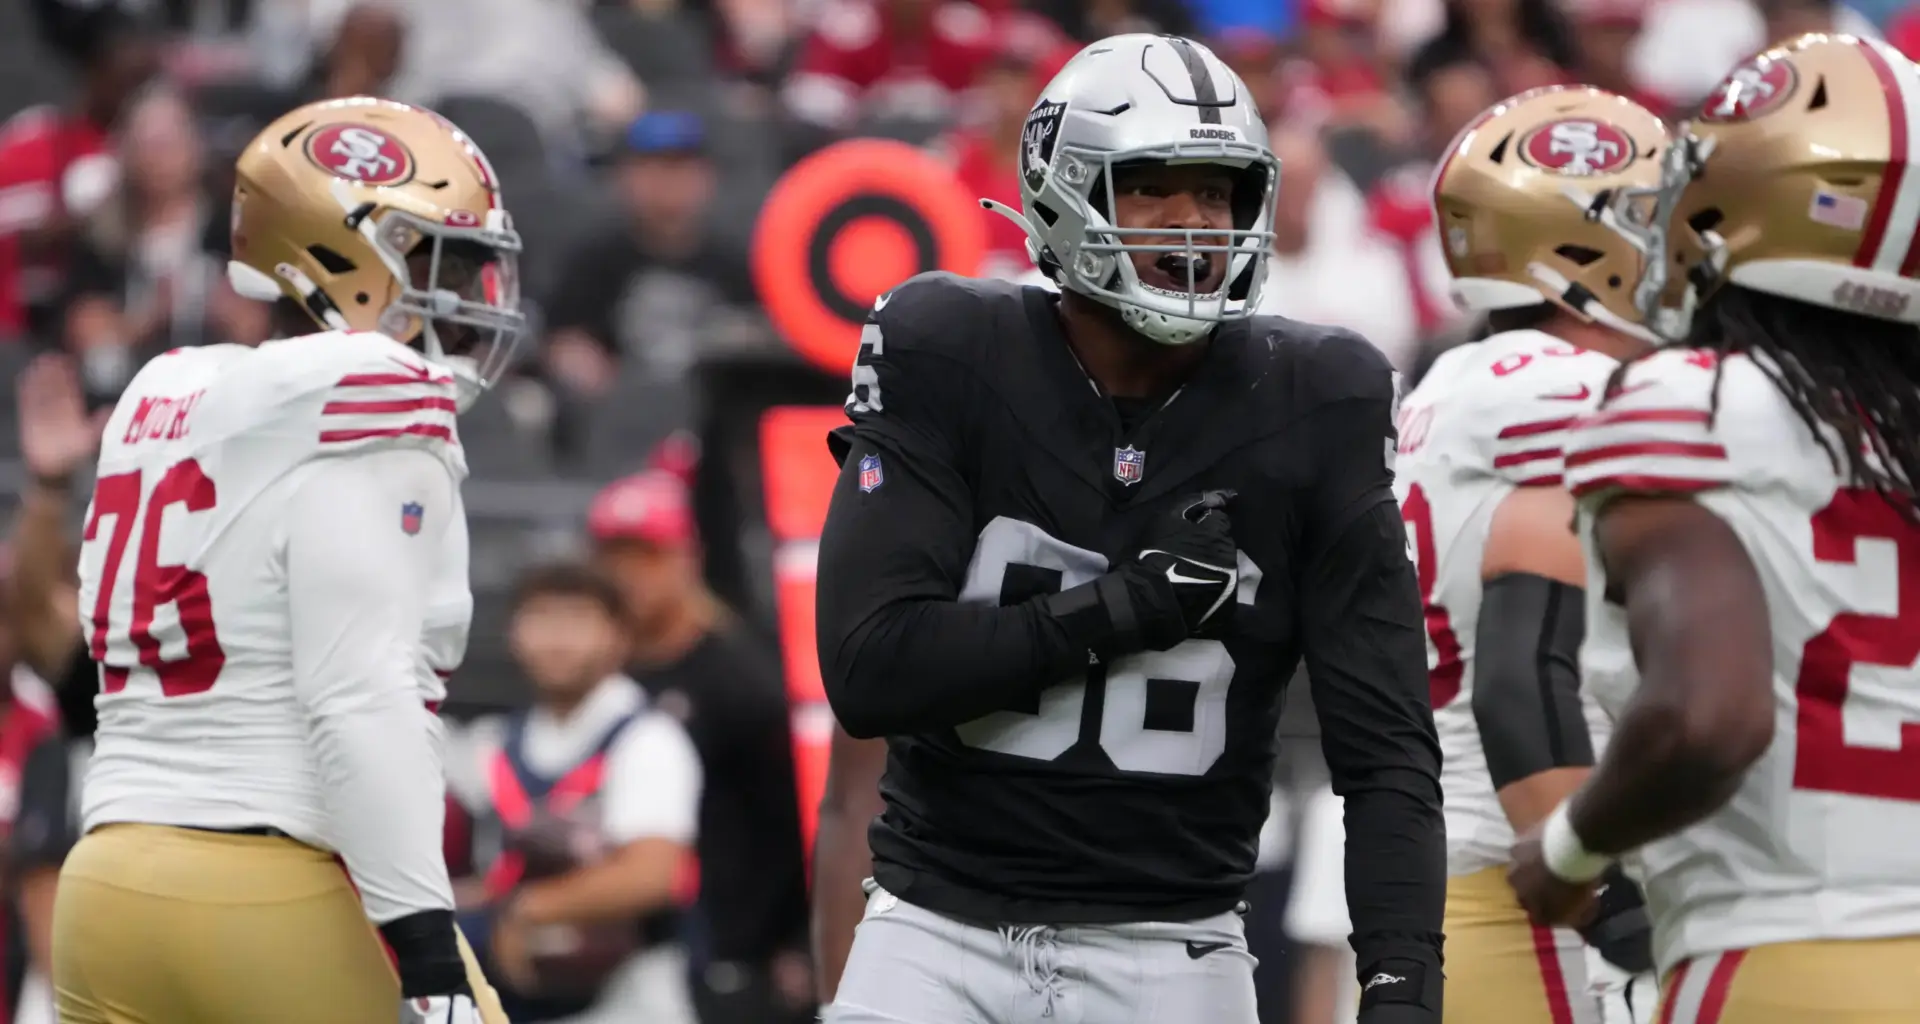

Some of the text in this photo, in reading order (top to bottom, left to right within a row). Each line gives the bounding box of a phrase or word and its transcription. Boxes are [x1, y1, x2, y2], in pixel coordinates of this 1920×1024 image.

[330, 127, 397, 179] SF
[1189, 128, 1237, 141] RAIDERS
[83, 457, 226, 697] 76
[953, 515, 1264, 777] 96
